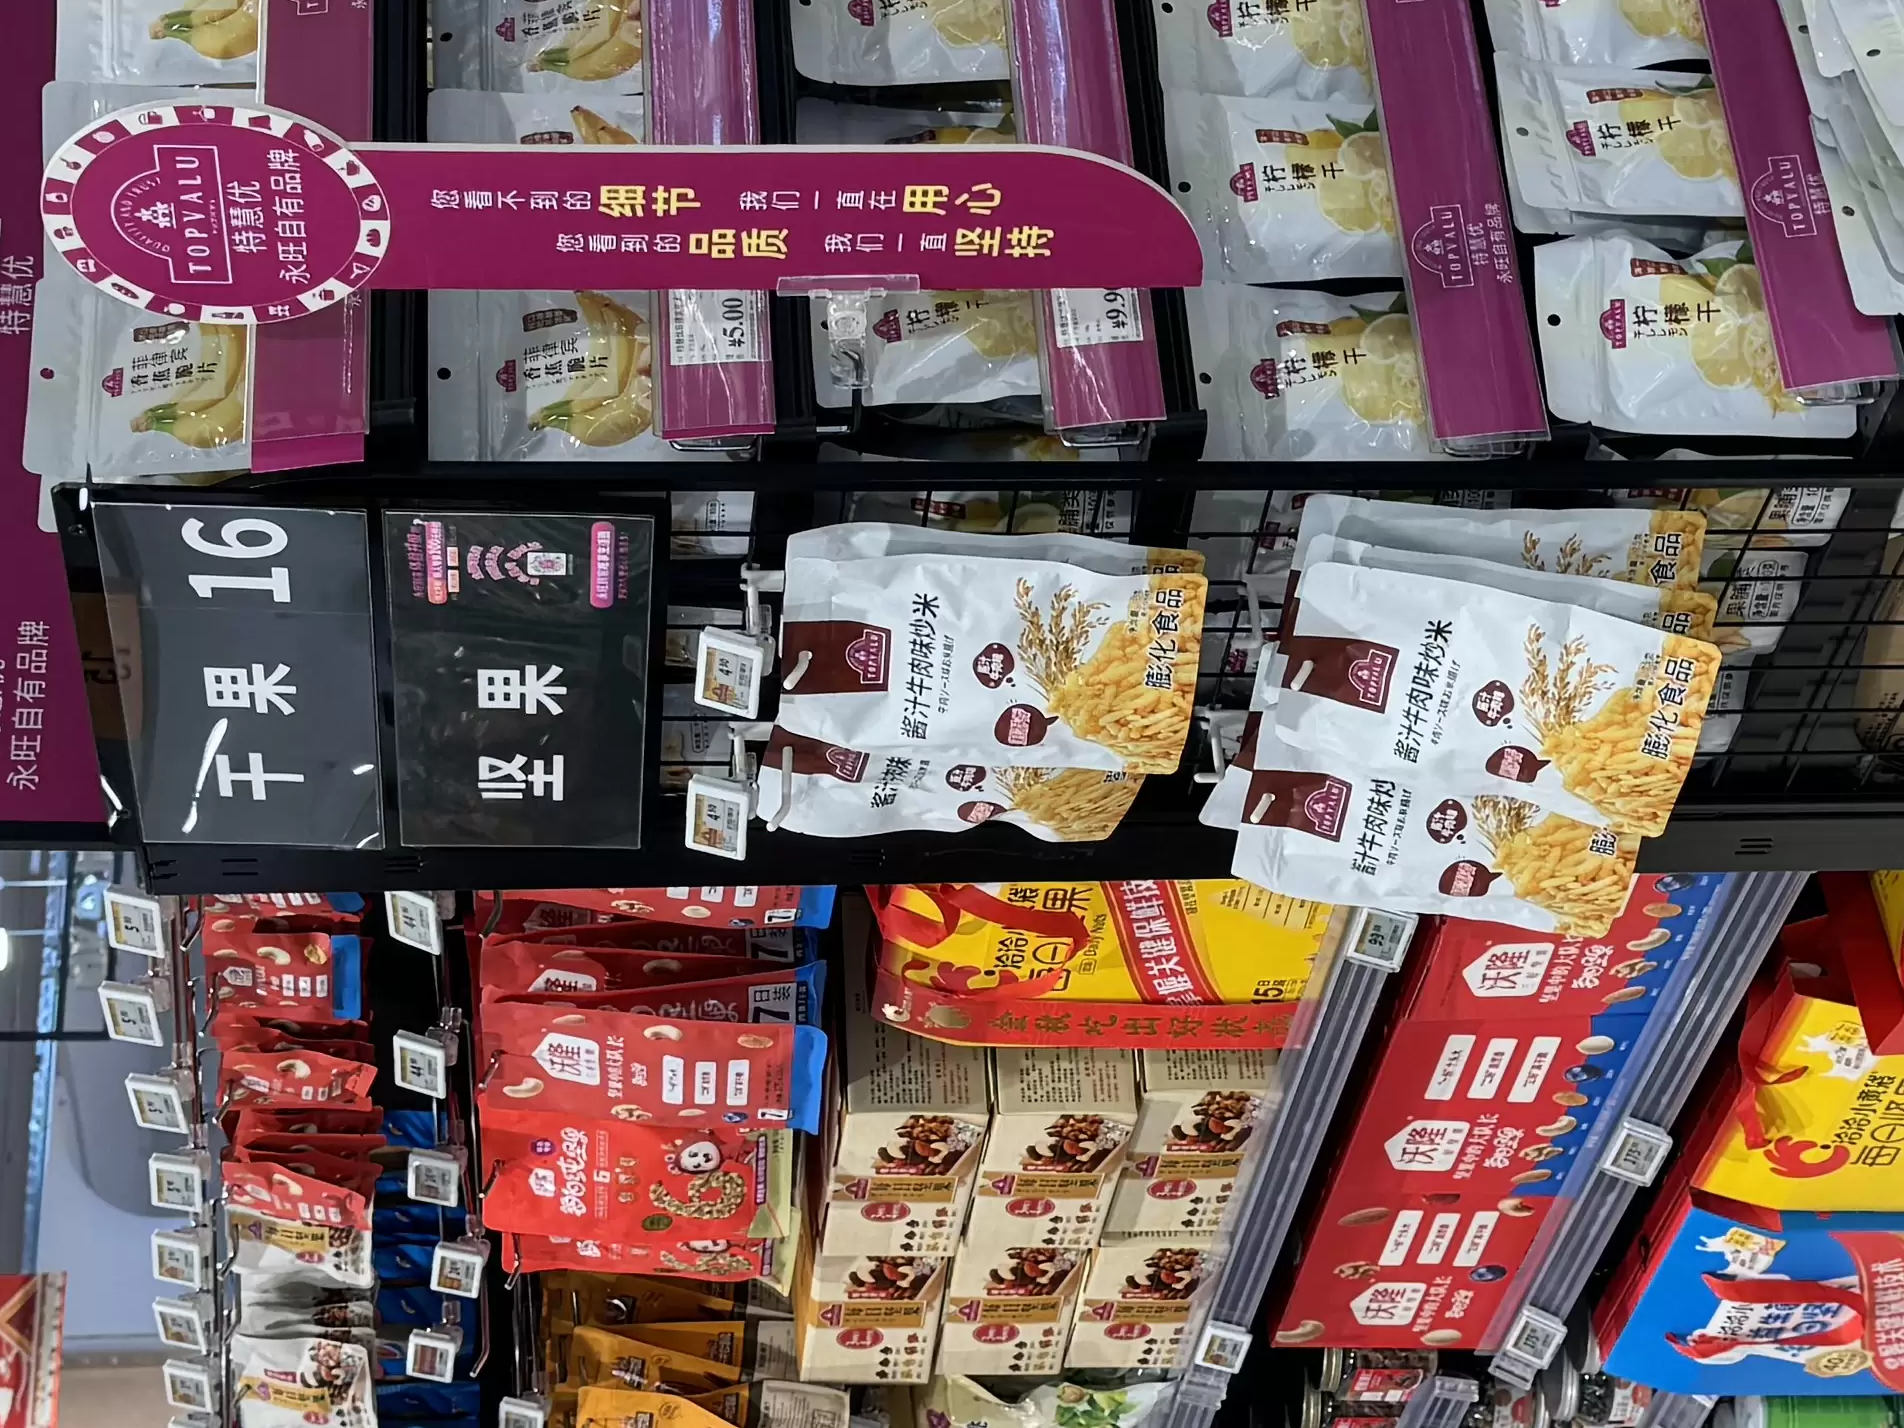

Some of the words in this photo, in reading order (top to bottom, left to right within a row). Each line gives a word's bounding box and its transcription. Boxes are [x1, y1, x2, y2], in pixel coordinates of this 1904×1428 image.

[1596, 114, 1683, 142] 柠檬干
[429, 183, 703, 219] 您看不到的细节
[737, 182, 1003, 217] 我们一直在用心
[1261, 159, 1347, 184] 柠檬干
[1776, 160, 1806, 232] TOPVALU
[120, 196, 136, 219] AND
[121, 218, 171, 253] QUALITY
[172, 154, 210, 276] TOPVALU
[226, 180, 269, 255] 特慧优
[266, 147, 312, 286] 永旺自有品牌
[554, 227, 790, 260] 您看到的品质
[823, 224, 1056, 259] 我们一直坚持
[1440, 209, 1464, 282] TOPVALU
[1484, 202, 1514, 285] 永旺自有品牌
[1630, 299, 1722, 328] 柠檬干
[522, 355, 609, 382] 香蕉脆片
[523, 336, 579, 365] 菲律宾
[1281, 346, 1368, 376] 柠檬干
[181, 516, 292, 604] 16
[898, 591, 942, 741] 酱汁牛肉味炒米
[1142, 586, 1185, 691] 膨化食品
[6, 619, 52, 791] 永旺自有品牌
[1391, 617, 1456, 765] 酱汁牛肉味炒米
[1639, 656, 1697, 761] 膨化食品
[202, 661, 305, 801] 干果
[476, 663, 568, 802] 坚果
[1476, 948, 1534, 993] 沃隆
[750, 1005, 791, 1023] 7
[543, 1042, 583, 1077] 沃隆
[1831, 1072, 1897, 1147] 洽洽小黄袋
[1395, 1126, 1449, 1166] 沃隆
[1451, 1112, 1500, 1181] 坚果中的大队长
[1359, 1287, 1409, 1321] 沃隆
